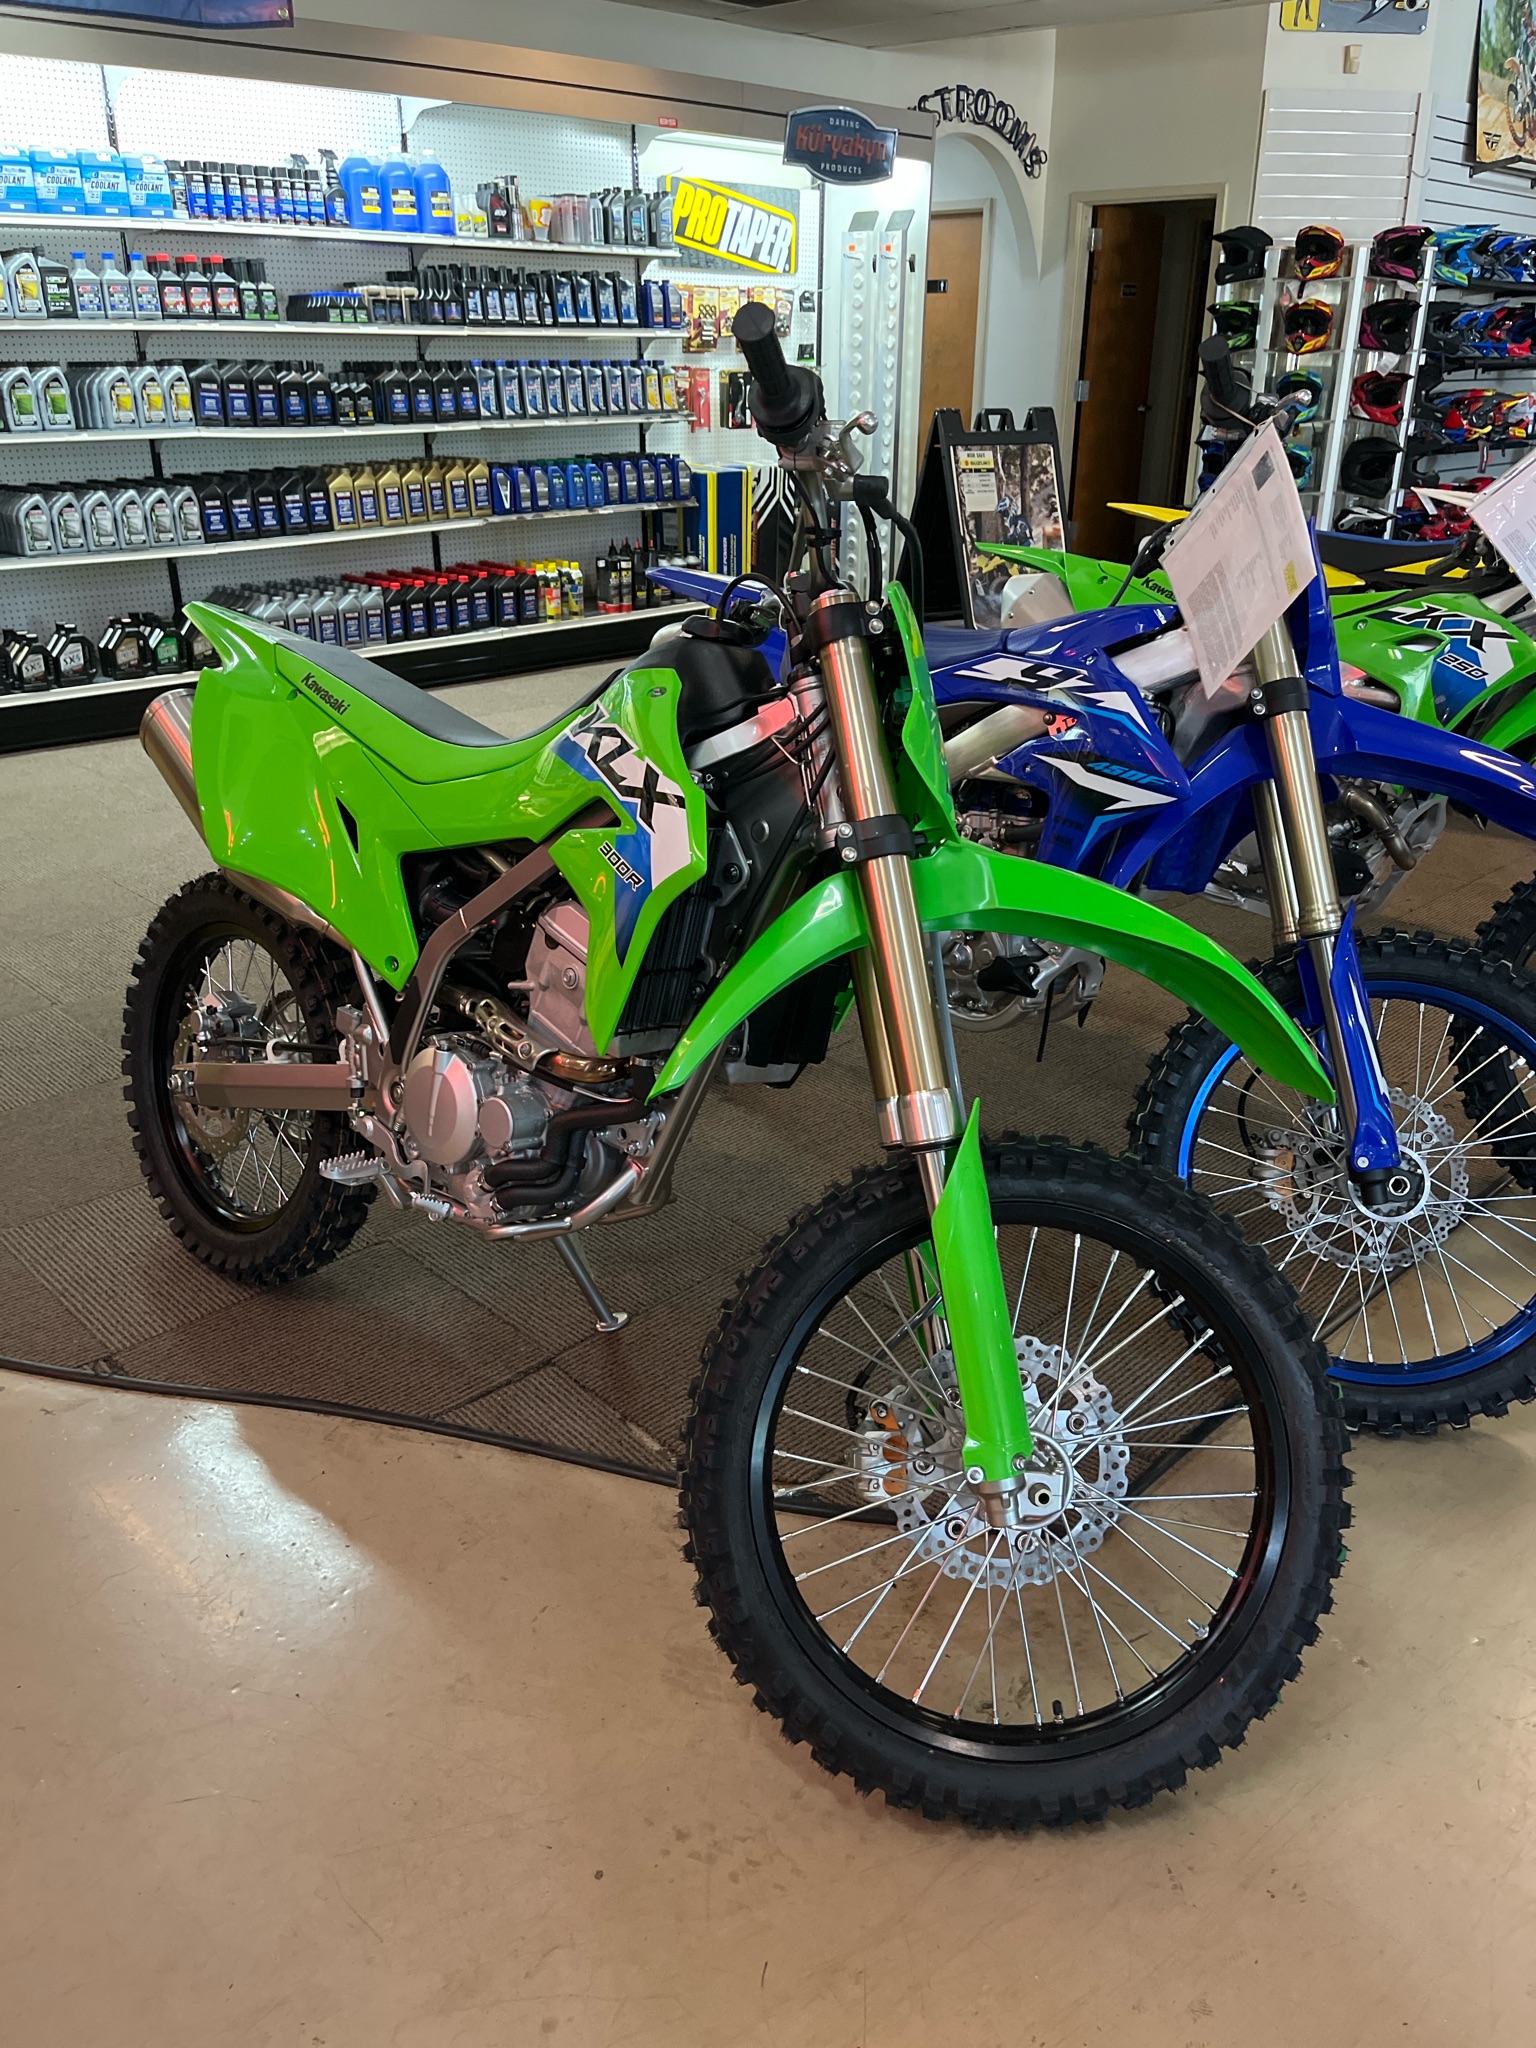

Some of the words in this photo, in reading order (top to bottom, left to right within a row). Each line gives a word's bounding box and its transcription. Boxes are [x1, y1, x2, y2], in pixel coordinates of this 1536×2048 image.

[829, 117, 860, 129] DARING
[820, 162, 862, 175] PRODUCTS
[46, 175, 77, 186] COOLANT
[90, 180, 120, 191] COOLANT
[135, 182, 164, 193] COOLANT
[1392, 602, 1518, 653] KX
[1438, 653, 1489, 680] 250
[301, 672, 351, 716] Kawasaki
[564, 699, 686, 834] KLX
[598, 841, 645, 893] 300R
